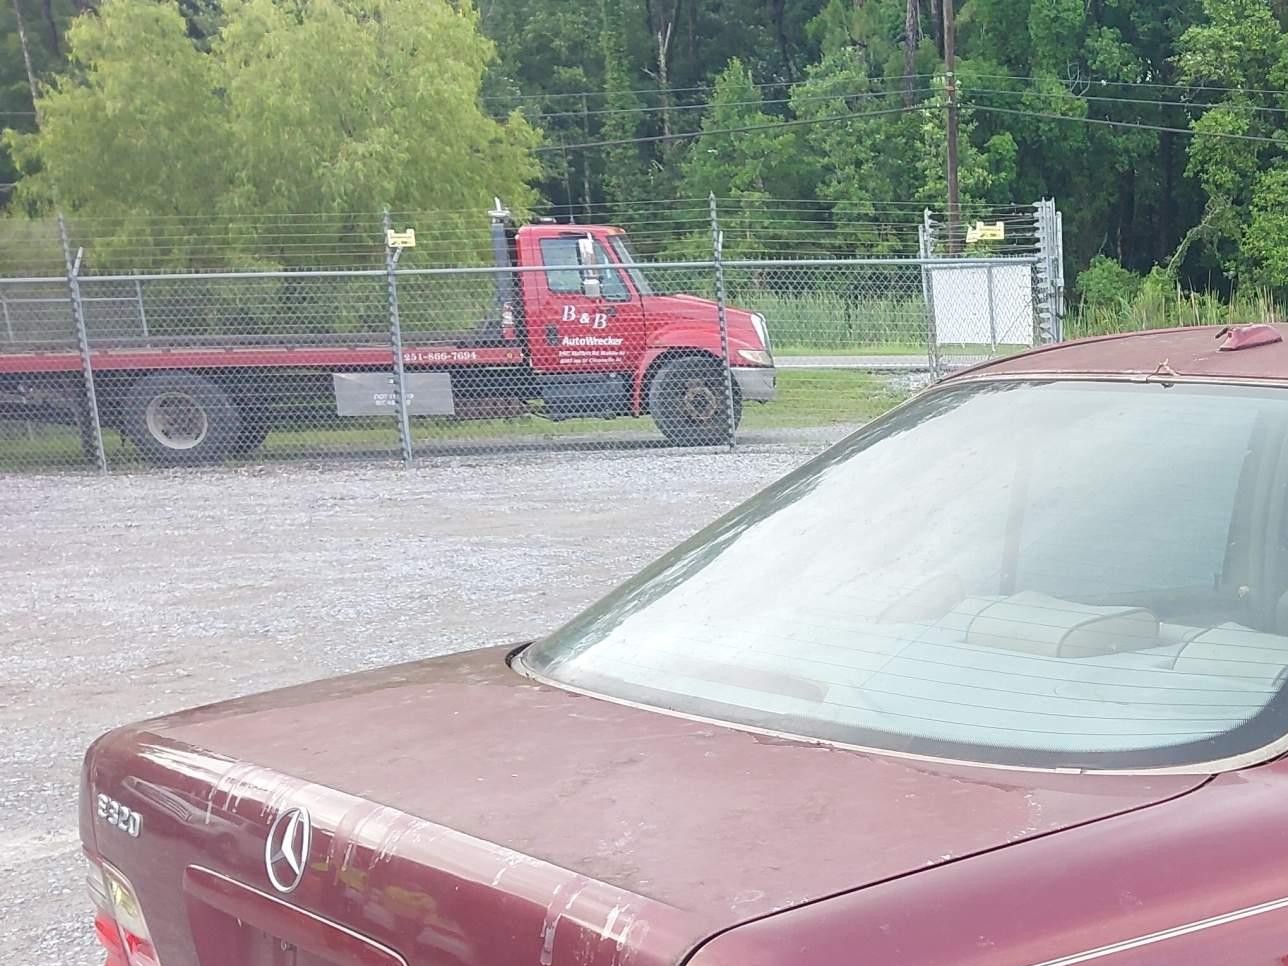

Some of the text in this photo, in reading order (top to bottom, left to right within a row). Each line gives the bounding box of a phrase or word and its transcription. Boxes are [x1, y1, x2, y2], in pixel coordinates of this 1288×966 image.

[562, 304, 608, 329] B & B
[562, 335, 624, 346] AutoWrecker
[97, 793, 142, 838] E320
